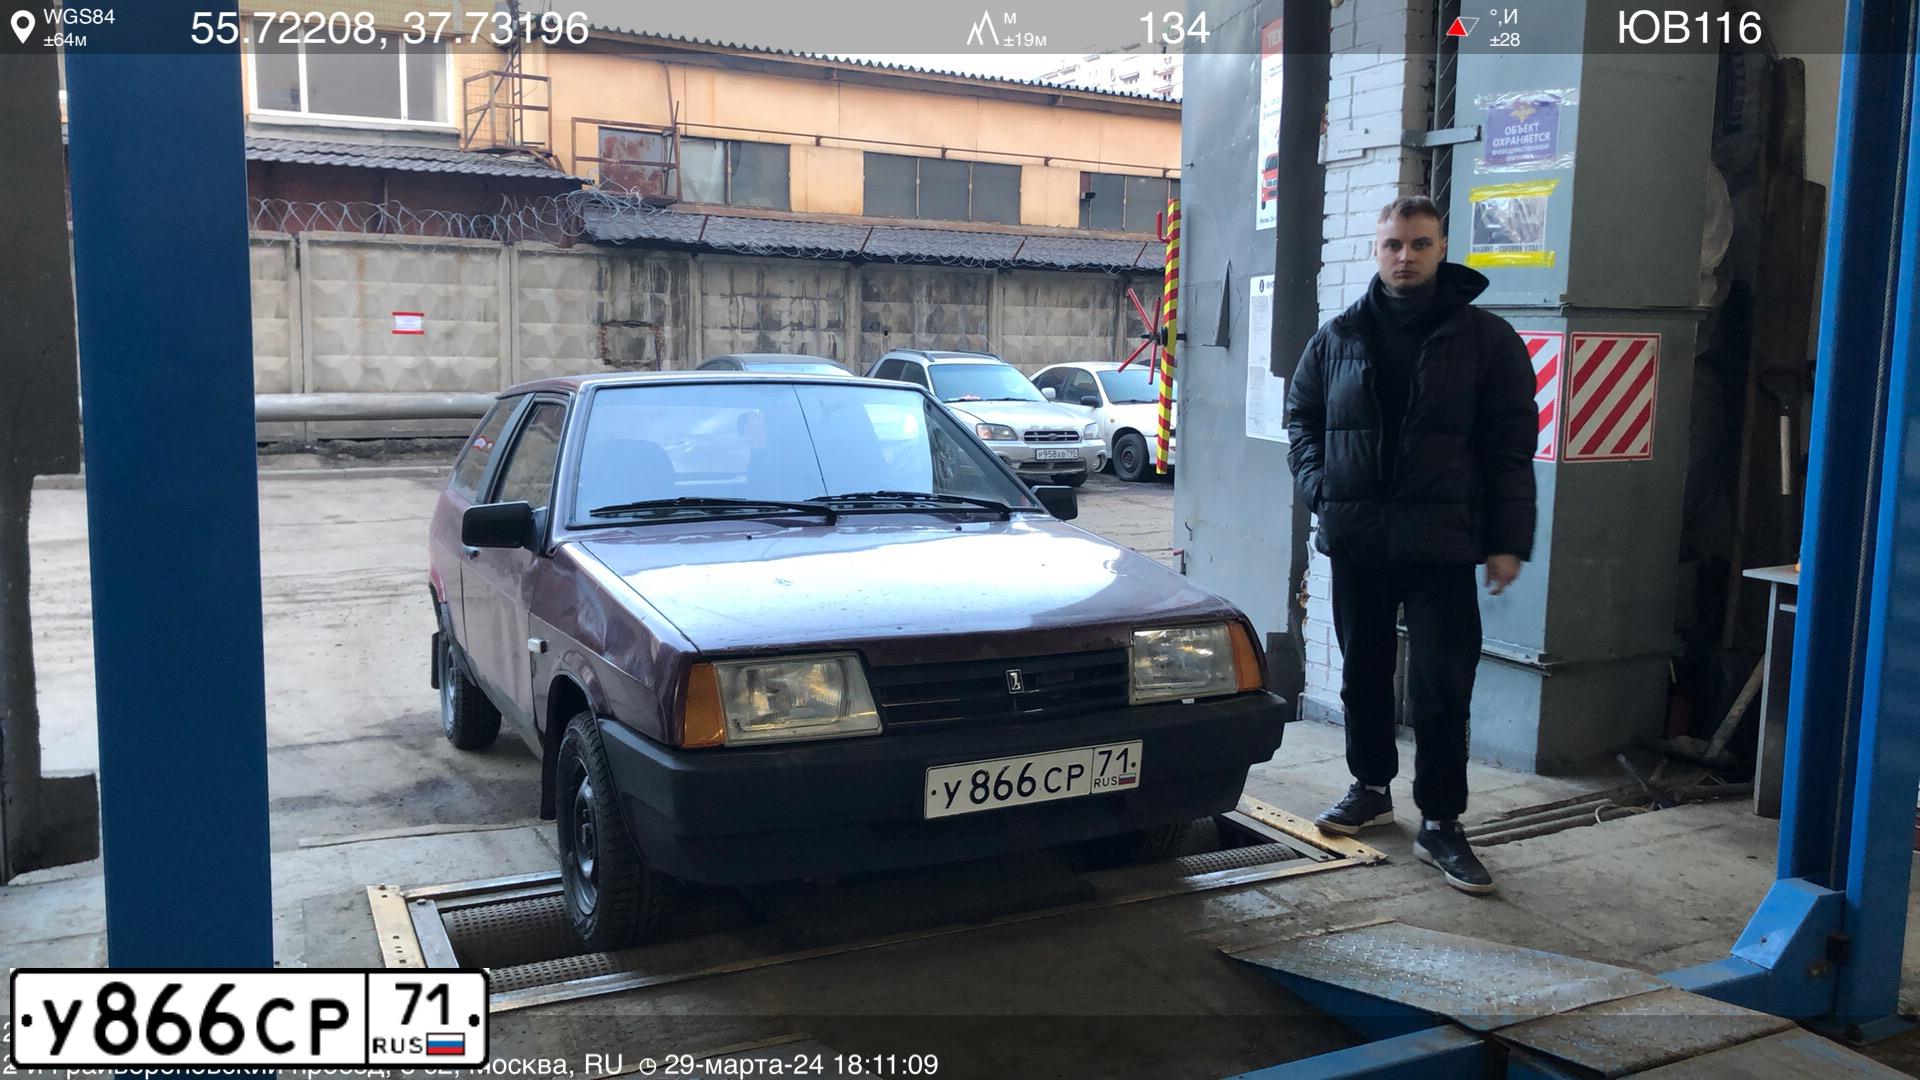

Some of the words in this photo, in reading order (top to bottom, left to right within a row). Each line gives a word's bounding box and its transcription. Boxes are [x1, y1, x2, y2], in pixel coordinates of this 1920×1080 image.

[1504, 122, 1540, 135] ОБЪЕКТ
[1492, 131, 1550, 147] ОХРАНЯЕТСЯ
[1098, 747, 1129, 777] 71
[944, 762, 1085, 809] У866СР
[1094, 776, 1118, 788] RUS
